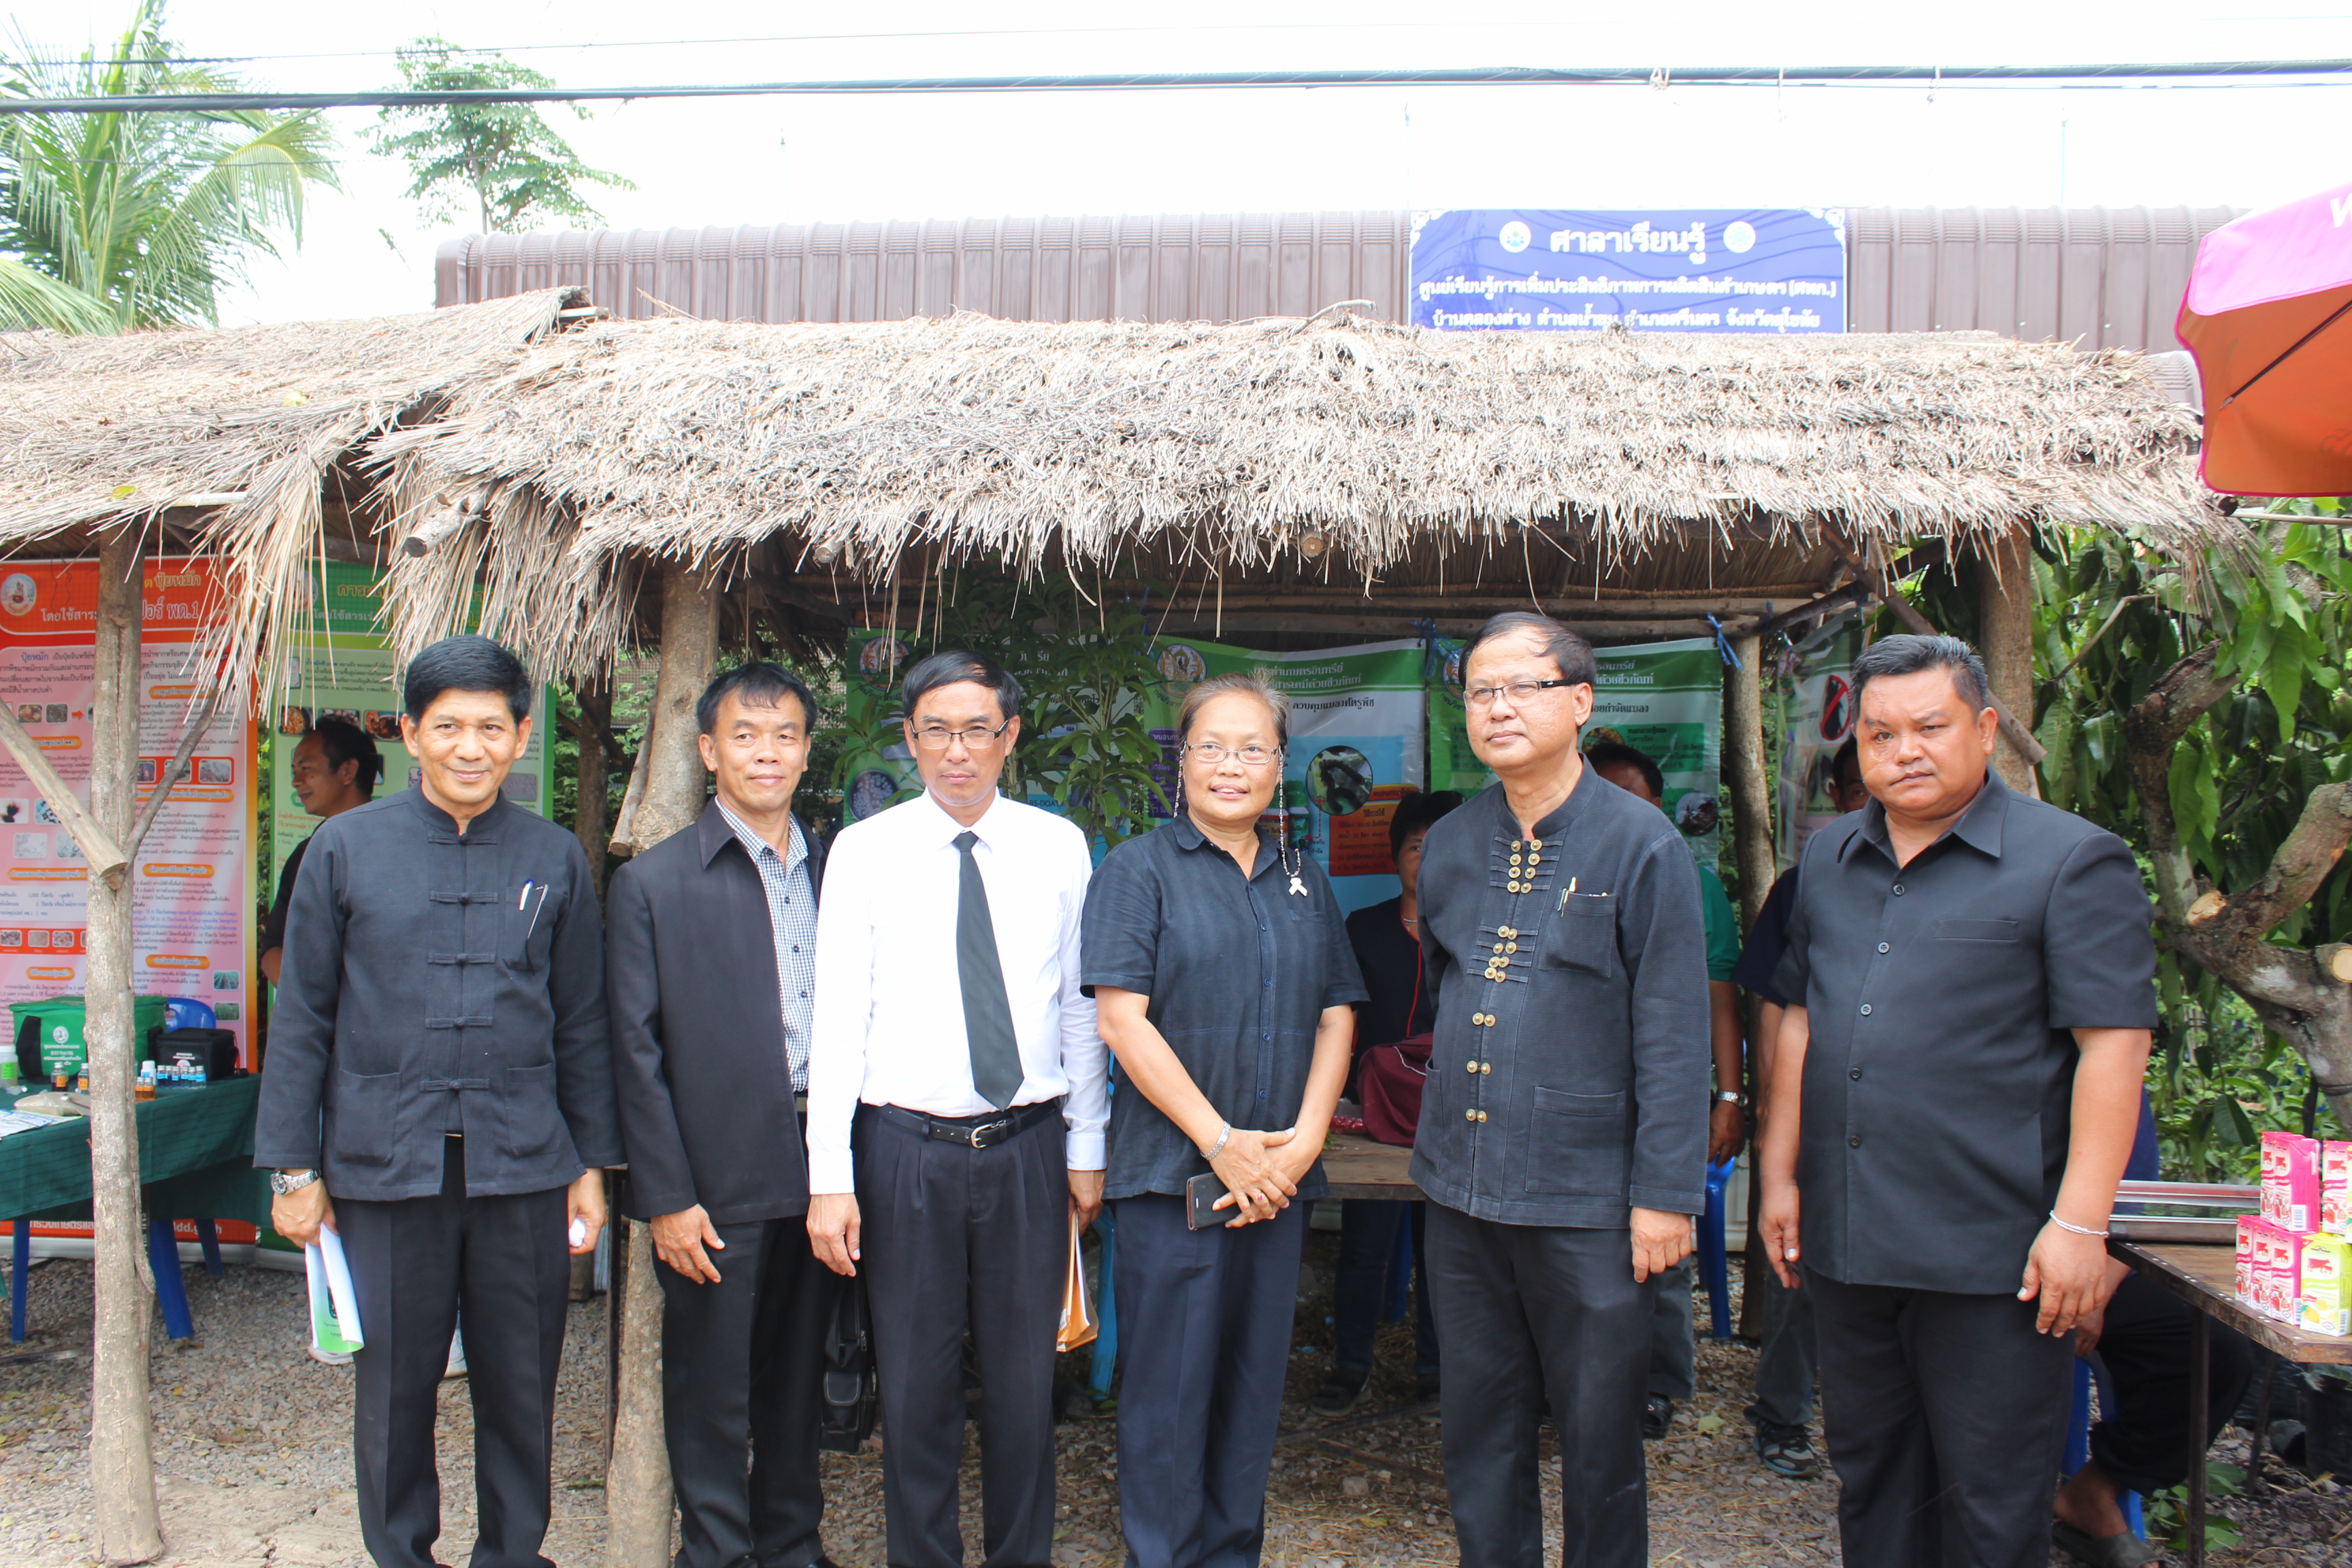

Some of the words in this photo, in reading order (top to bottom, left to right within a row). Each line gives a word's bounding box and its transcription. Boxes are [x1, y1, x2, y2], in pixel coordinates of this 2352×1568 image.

[1550, 221, 1706, 264] ศาลาเรียนรู้
